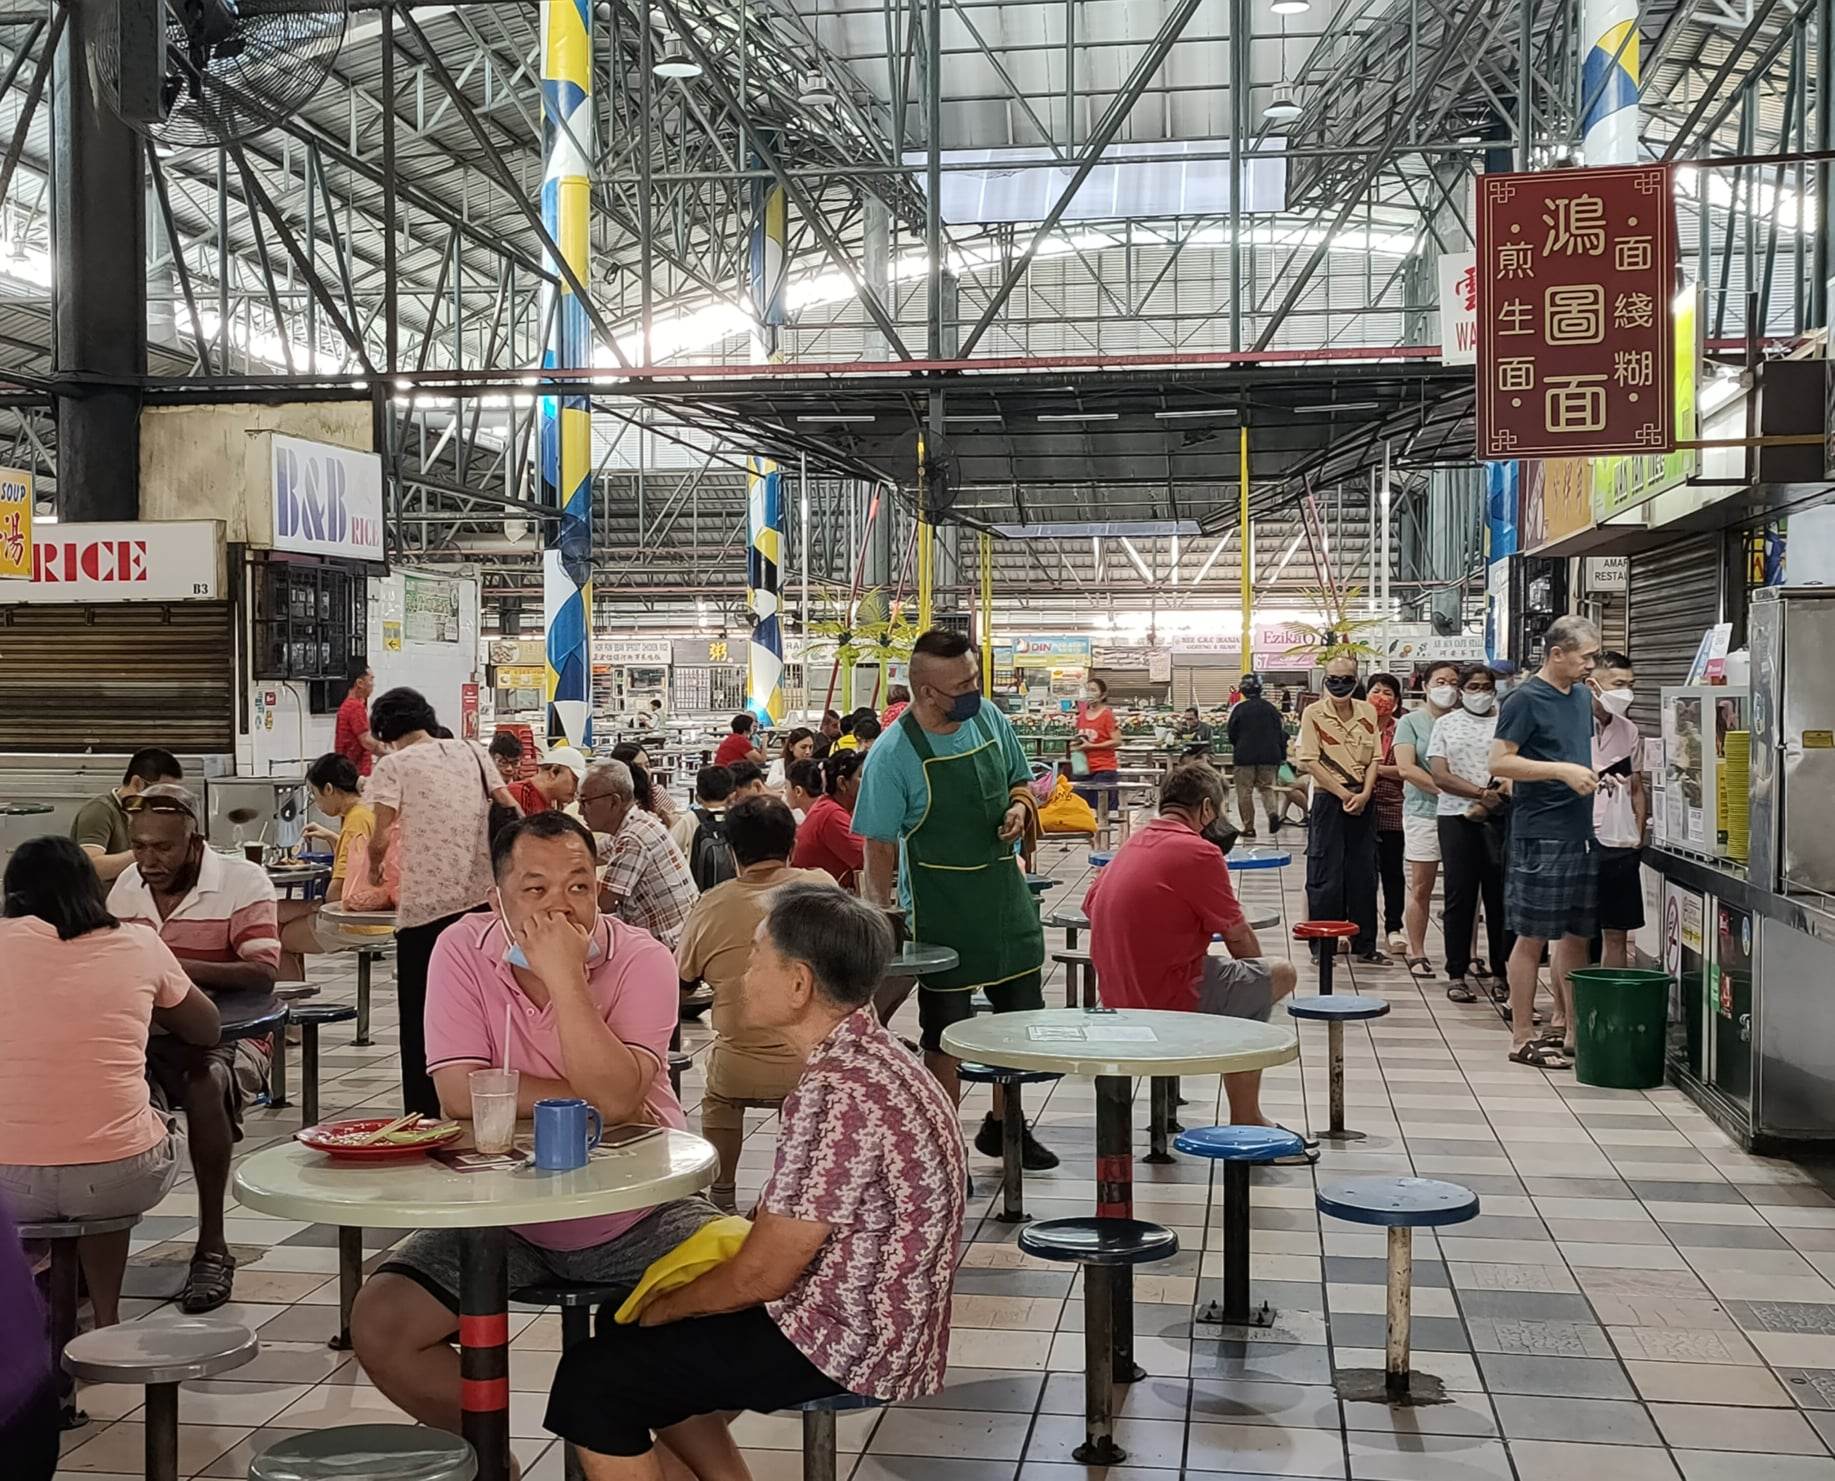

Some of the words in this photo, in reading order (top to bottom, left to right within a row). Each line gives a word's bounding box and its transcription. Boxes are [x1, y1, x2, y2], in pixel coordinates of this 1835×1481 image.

[1496, 241, 1536, 392] 煎生面
[1541, 193, 1608, 433] 鴻圖面
[1, 483, 26, 502] SOUP
[275, 446, 347, 543] B&B
[351, 516, 379, 547] RICE
[30, 541, 147, 582] RICE
[193, 584, 209, 595] B3
[708, 642, 728, 662] 粥
[1255, 654, 1270, 668] 67
